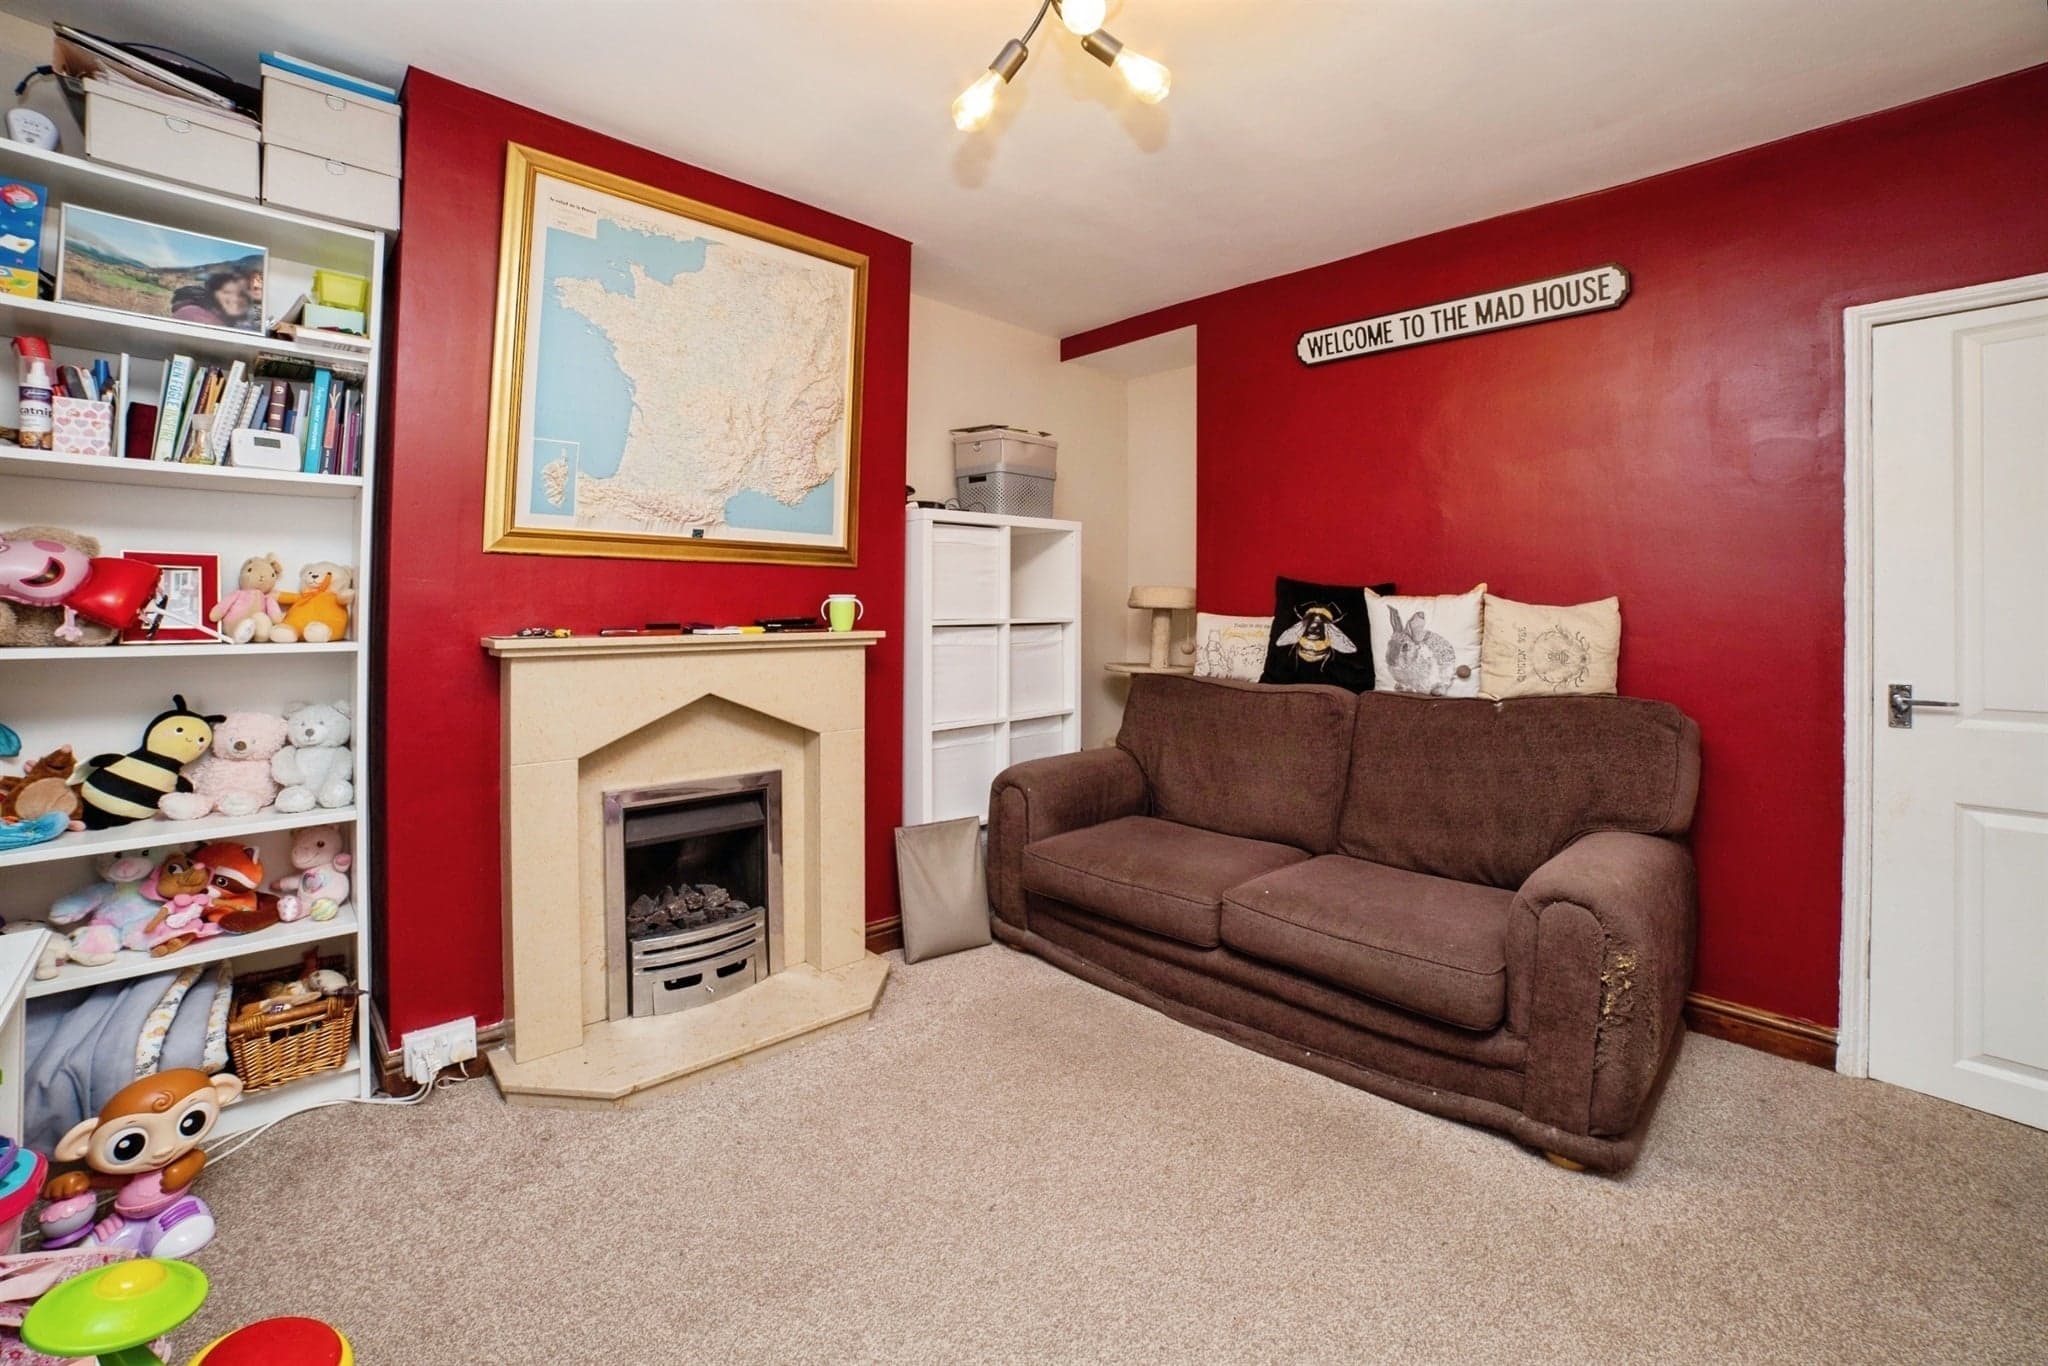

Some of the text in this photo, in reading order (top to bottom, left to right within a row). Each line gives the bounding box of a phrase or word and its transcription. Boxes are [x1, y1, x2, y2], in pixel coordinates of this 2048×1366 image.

[1306, 272, 1612, 358] WELCOME TO THE MAD HOUSE
[167, 381, 183, 408] FOGLE
